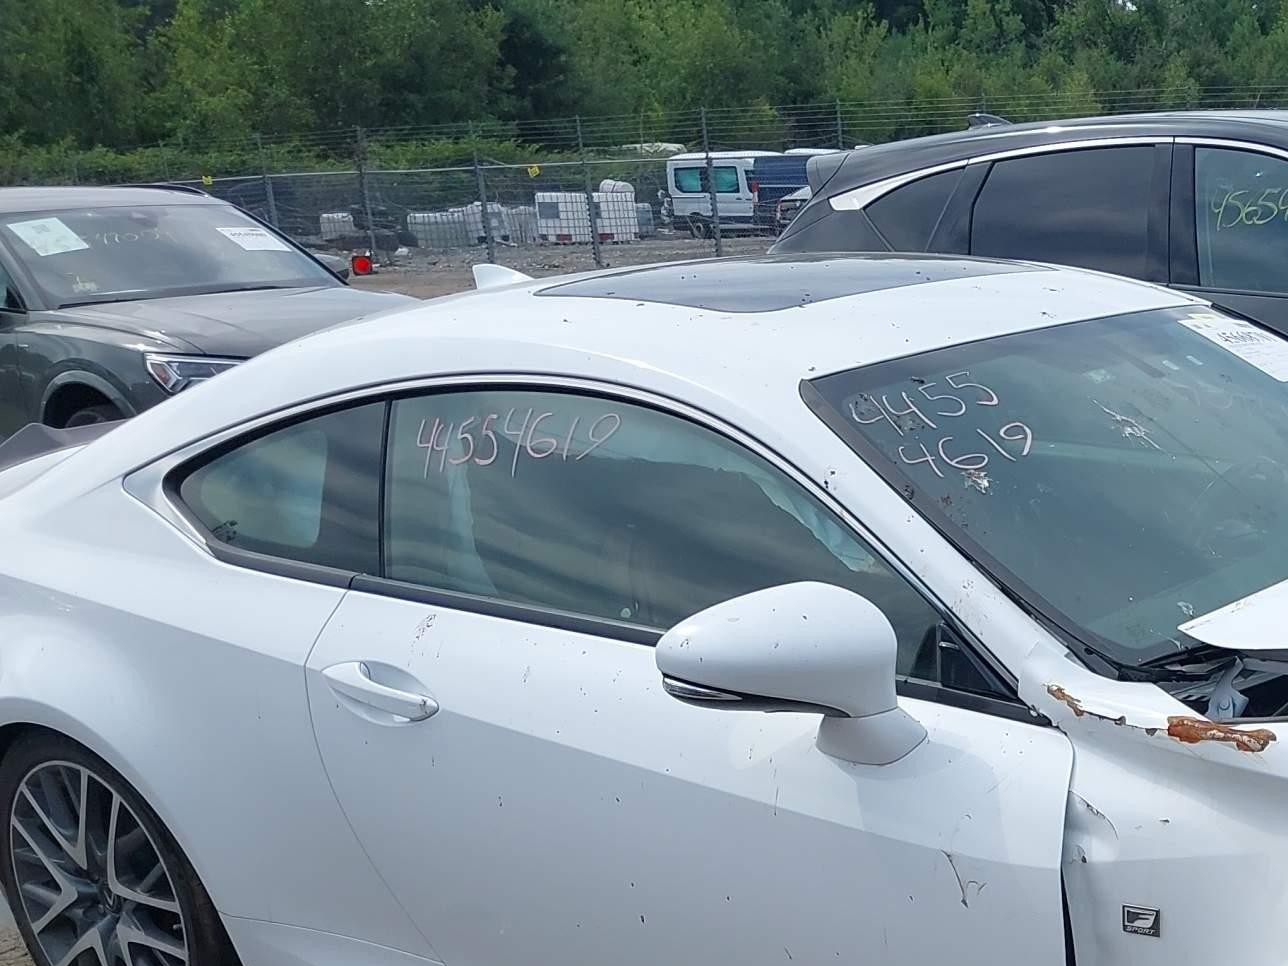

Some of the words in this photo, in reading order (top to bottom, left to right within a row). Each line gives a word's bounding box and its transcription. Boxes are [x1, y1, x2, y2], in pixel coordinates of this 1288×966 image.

[849, 371, 999, 437] 4455
[416, 407, 621, 480] 44554619
[898, 421, 1033, 478] 4619
[1126, 925, 1156, 935] SPORT
